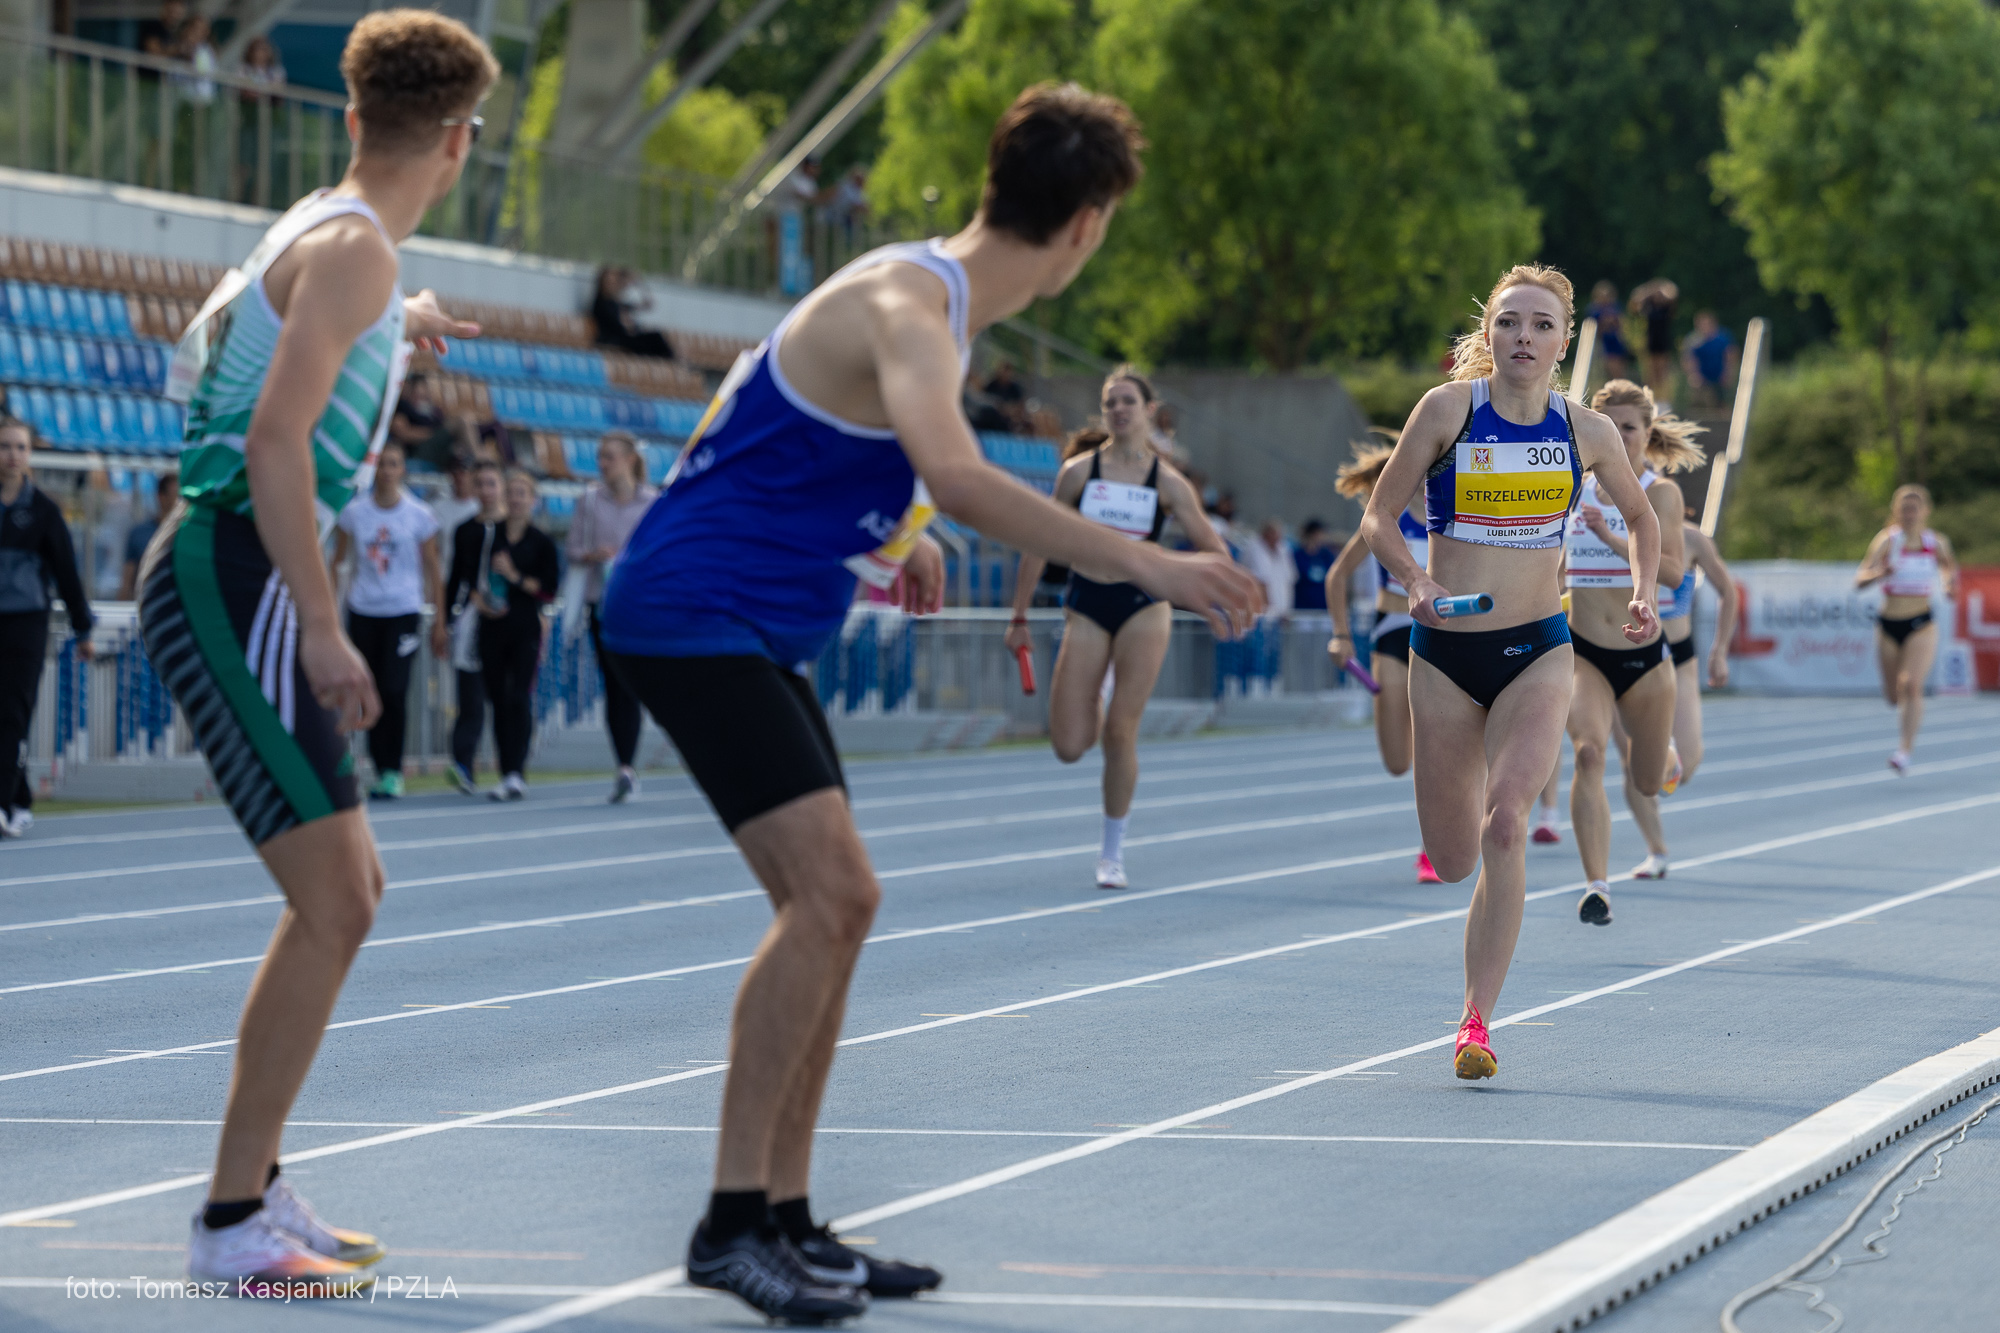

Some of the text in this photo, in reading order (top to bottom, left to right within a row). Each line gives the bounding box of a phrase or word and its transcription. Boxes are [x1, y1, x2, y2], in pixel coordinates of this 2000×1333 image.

[1526, 447, 1566, 466] 300
[1471, 463, 1493, 471] PZLA
[1465, 488, 1565, 503] STRZELEWICZ
[1605, 517, 1626, 531] 91
[1487, 528, 1540, 537] LUBLIN 2024
[1570, 547, 1619, 558] AJKOWSK
